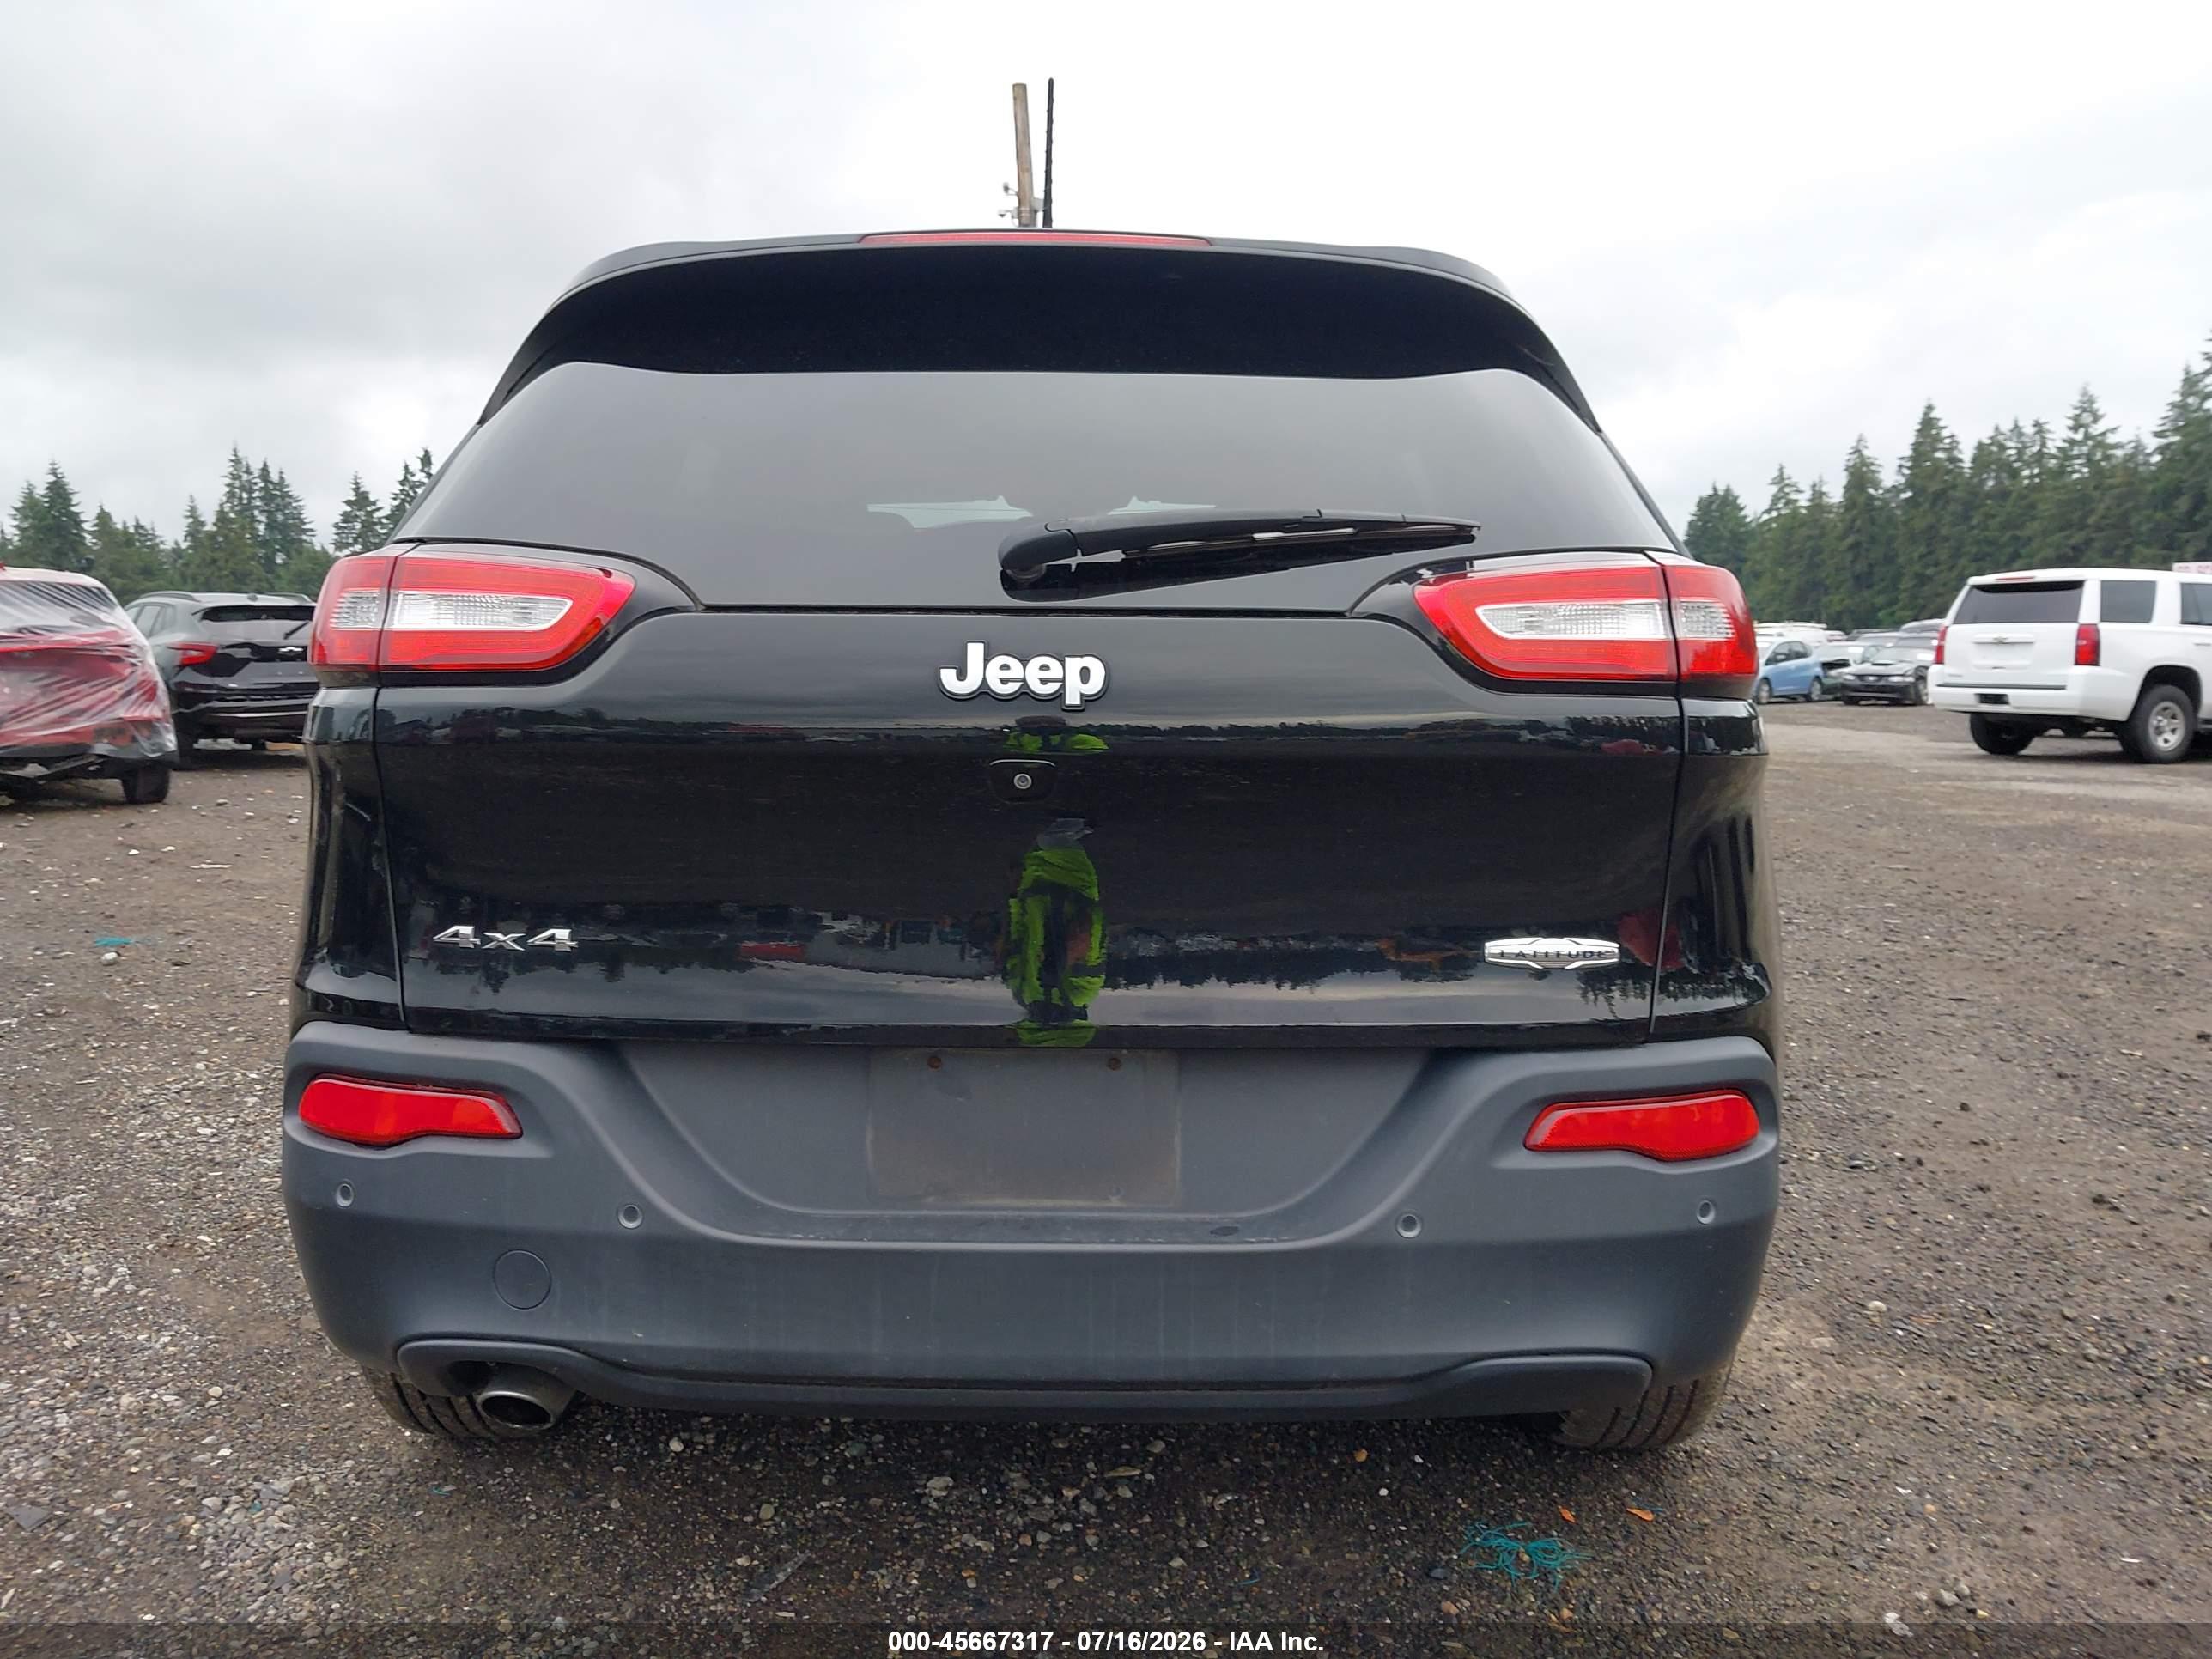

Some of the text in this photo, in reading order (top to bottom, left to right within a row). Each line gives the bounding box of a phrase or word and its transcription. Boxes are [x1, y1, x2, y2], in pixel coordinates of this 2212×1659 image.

[939, 641, 1108, 707] Jeep
[432, 925, 579, 952] 4x4
[1499, 949, 1608, 960] LATITUDE
